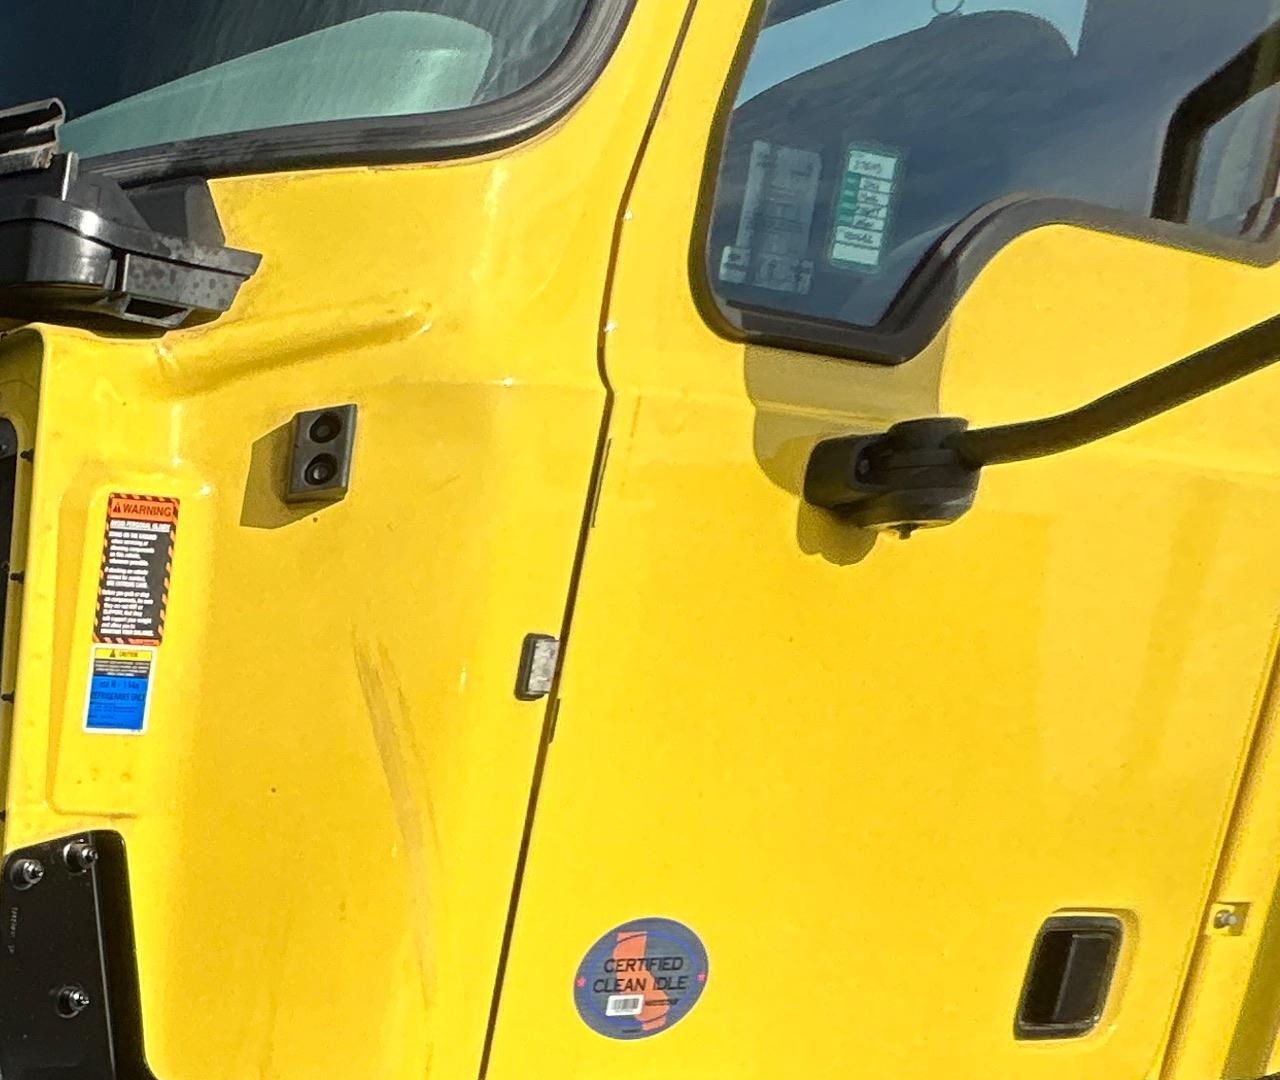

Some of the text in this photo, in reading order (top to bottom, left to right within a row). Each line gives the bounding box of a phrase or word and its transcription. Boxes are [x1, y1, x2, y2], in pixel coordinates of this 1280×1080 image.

[122, 503, 172, 517] WARNING
[603, 956, 684, 973] CERTIFIED
[593, 975, 689, 994] CLEAN IDLE
